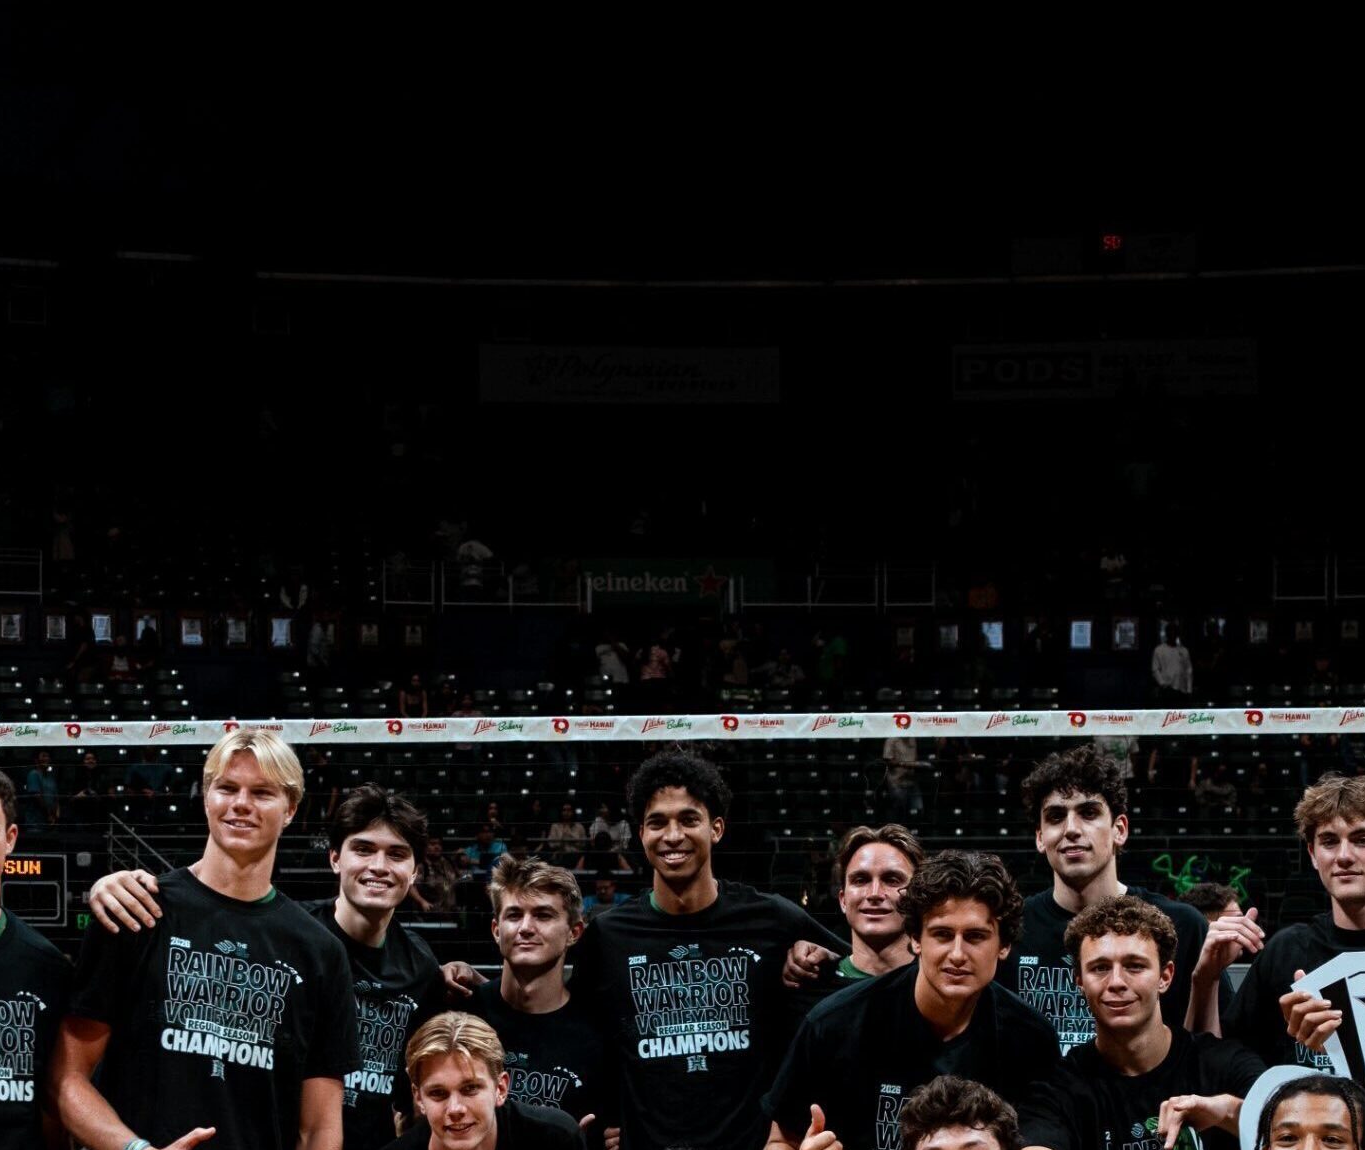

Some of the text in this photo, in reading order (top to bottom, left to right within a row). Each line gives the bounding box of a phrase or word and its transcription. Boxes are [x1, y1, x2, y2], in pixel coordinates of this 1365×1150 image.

[583, 571, 688, 592] eineken
[4, 860, 42, 876] SUN
[168, 947, 291, 997] RAINBOW
[629, 957, 748, 990] RAINBOW
[1019, 955, 1039, 965] 2026
[1019, 966, 1082, 993] RAIN
[167, 973, 285, 1023] WARRIOR
[631, 982, 750, 1014] WARRIOR
[188, 1019, 256, 1041] REGULAR SEASON
[659, 1022, 727, 1034] REGULAR SEASON
[161, 1027, 274, 1070] CHAMPIONS
[638, 1030, 750, 1059] CHAMPIONS
[880, 1084, 901, 1094] 2026
